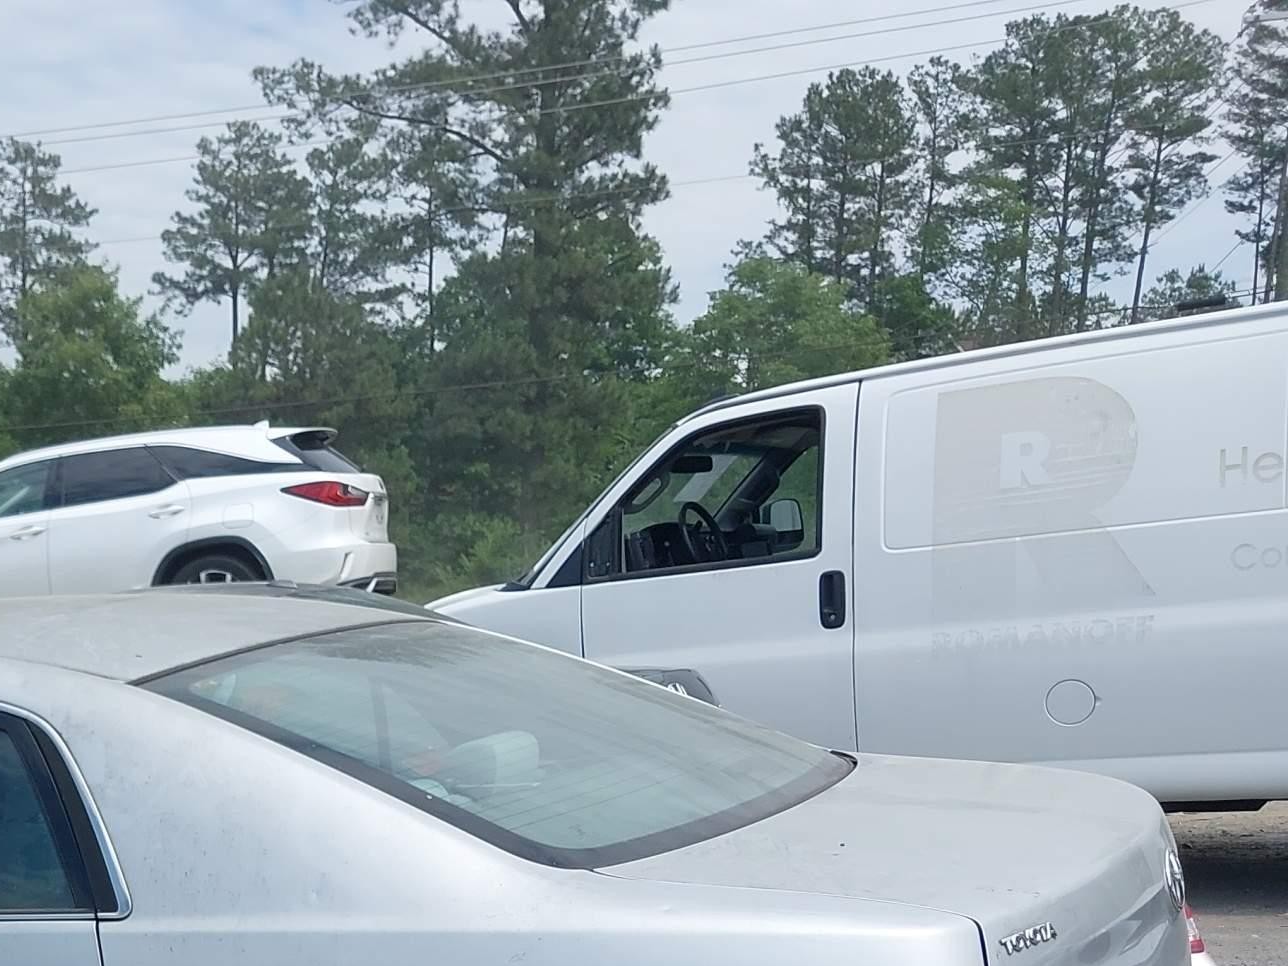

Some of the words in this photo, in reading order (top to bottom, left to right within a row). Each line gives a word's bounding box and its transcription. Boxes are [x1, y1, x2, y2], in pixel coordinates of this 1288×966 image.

[1000, 431, 1052, 489] R
[1230, 542, 1288, 570] Co
[998, 921, 1058, 956] TOYOTA
